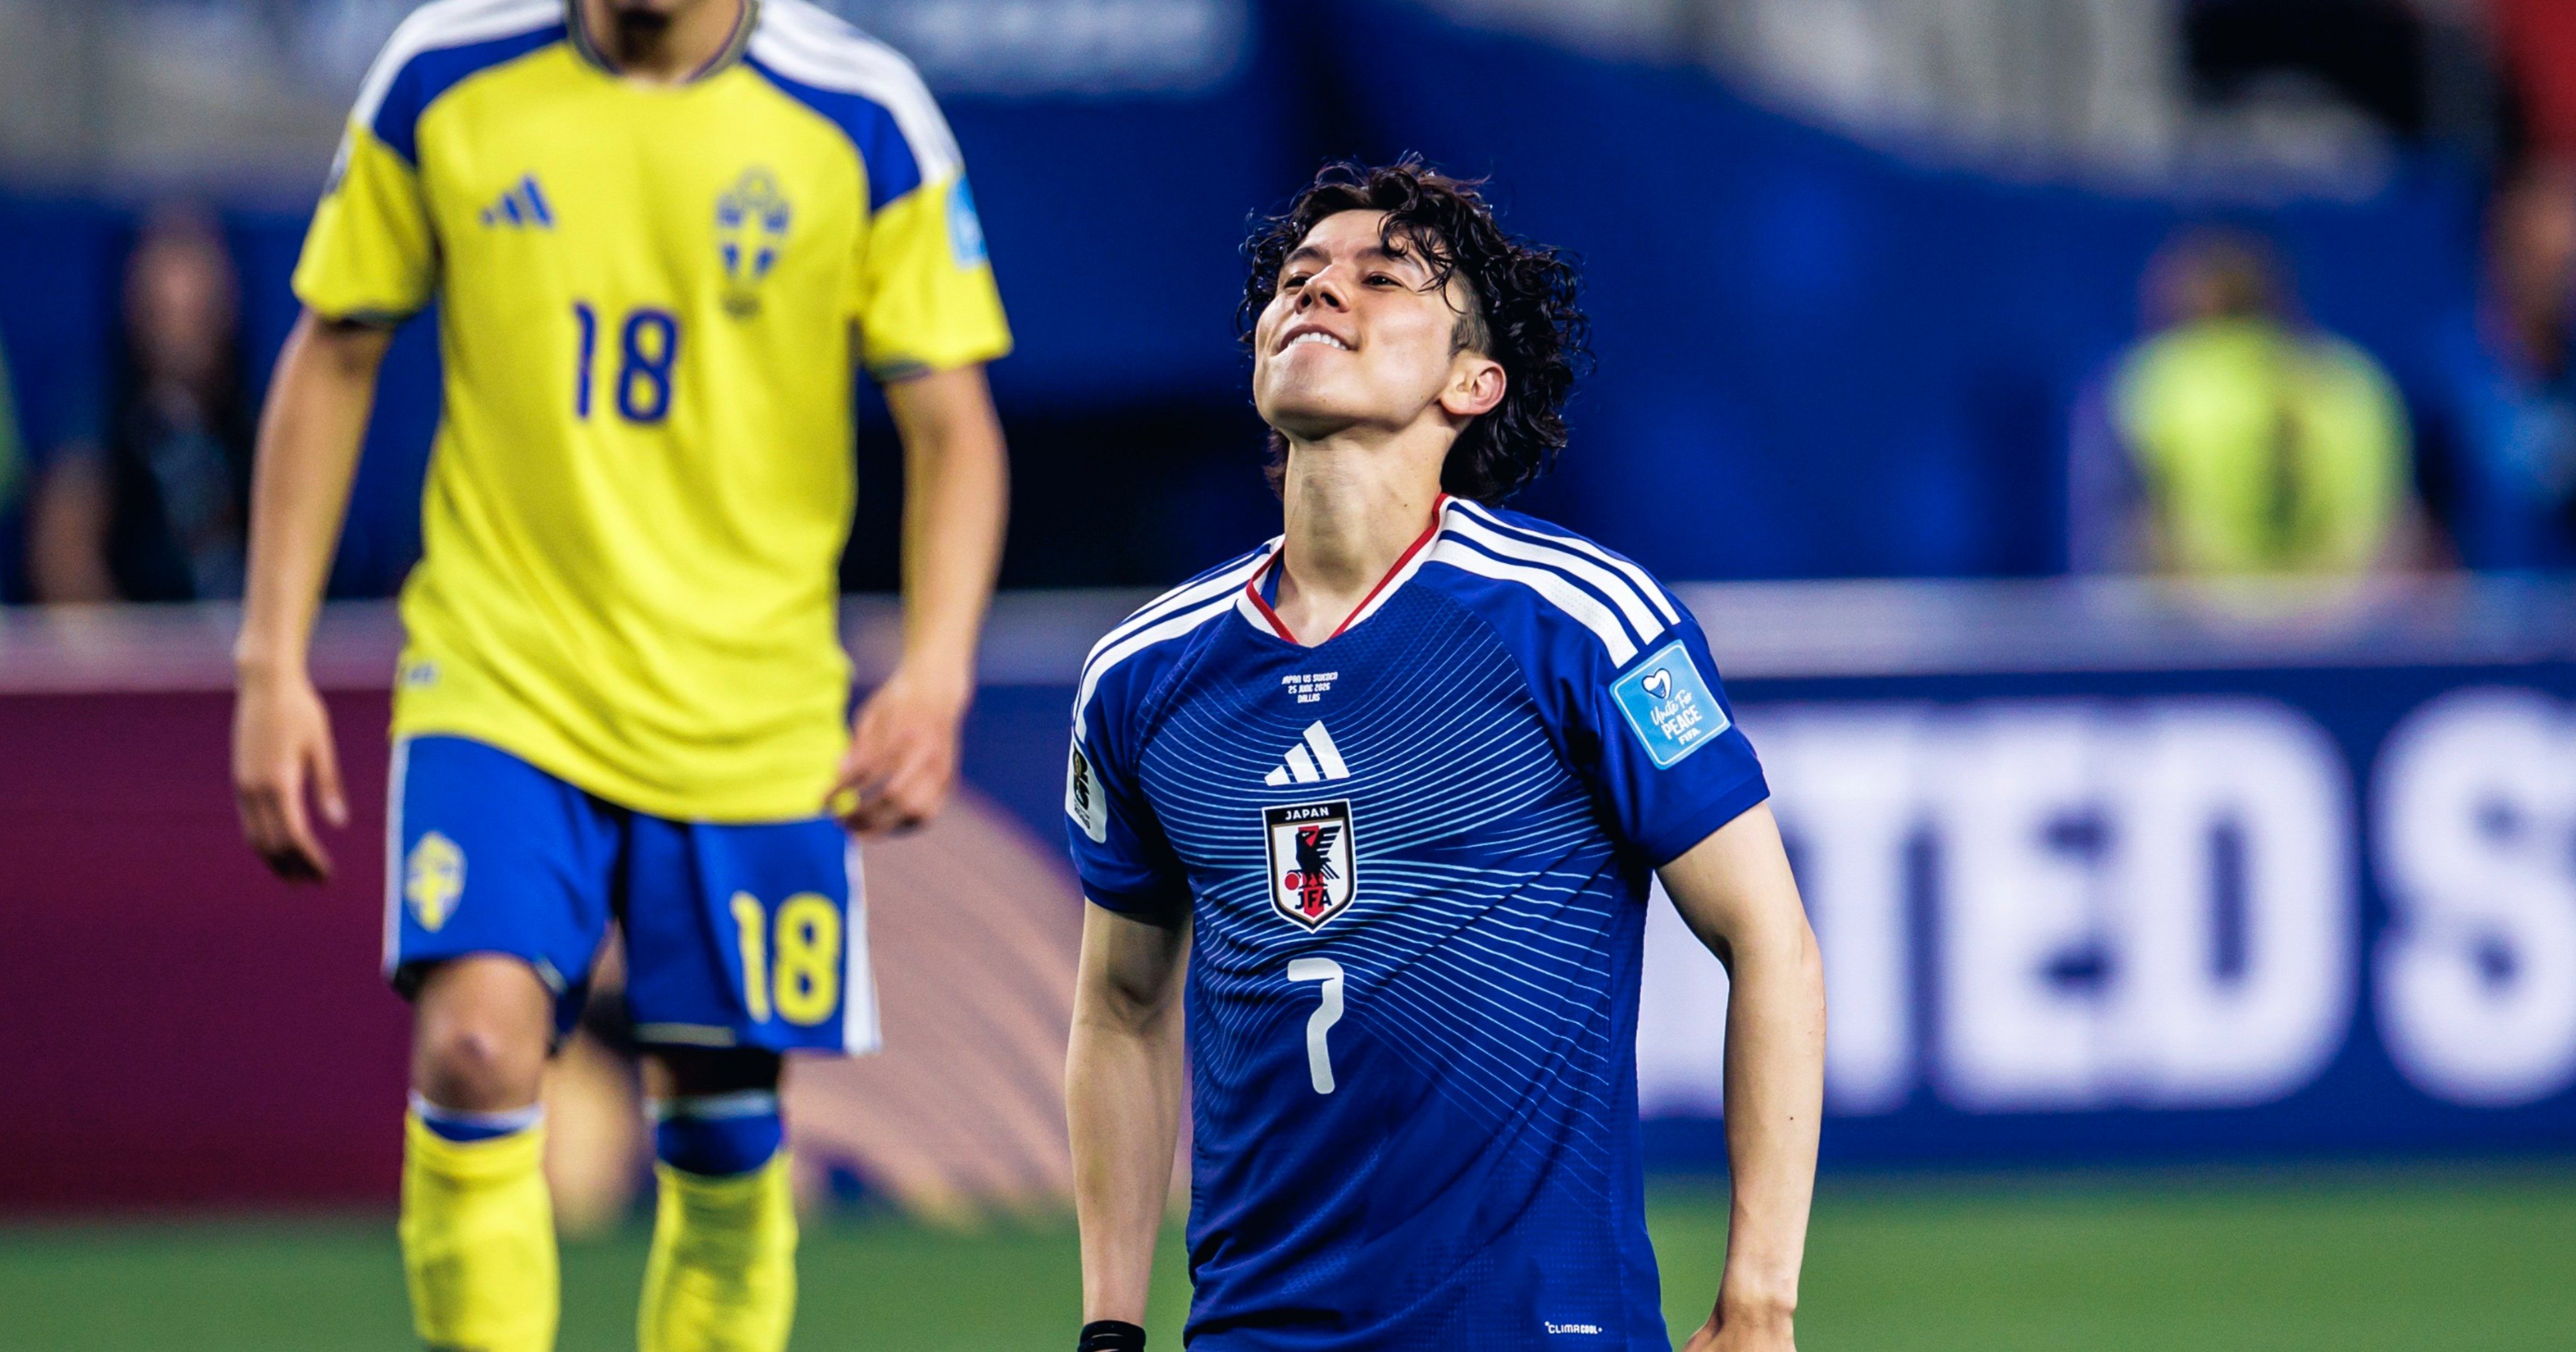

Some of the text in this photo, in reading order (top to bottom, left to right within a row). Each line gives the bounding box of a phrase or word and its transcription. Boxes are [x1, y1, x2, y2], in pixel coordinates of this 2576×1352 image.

[573, 300, 680, 423] 18
[1288, 685, 1297, 694] 25
[1314, 682, 1330, 692] 2026
[1297, 693, 1320, 703] DALLAS
[1650, 689, 1692, 726] Unite For
[1661, 704, 1702, 740] PEACE
[1678, 727, 1702, 746] FIFA
[1285, 807, 1329, 821] JAPAN
[1294, 888, 1333, 910] JFA
[731, 890, 843, 1026] 18
[1287, 957, 1344, 1094] 7
[1548, 1324, 1598, 1334] CLIMACOOL
